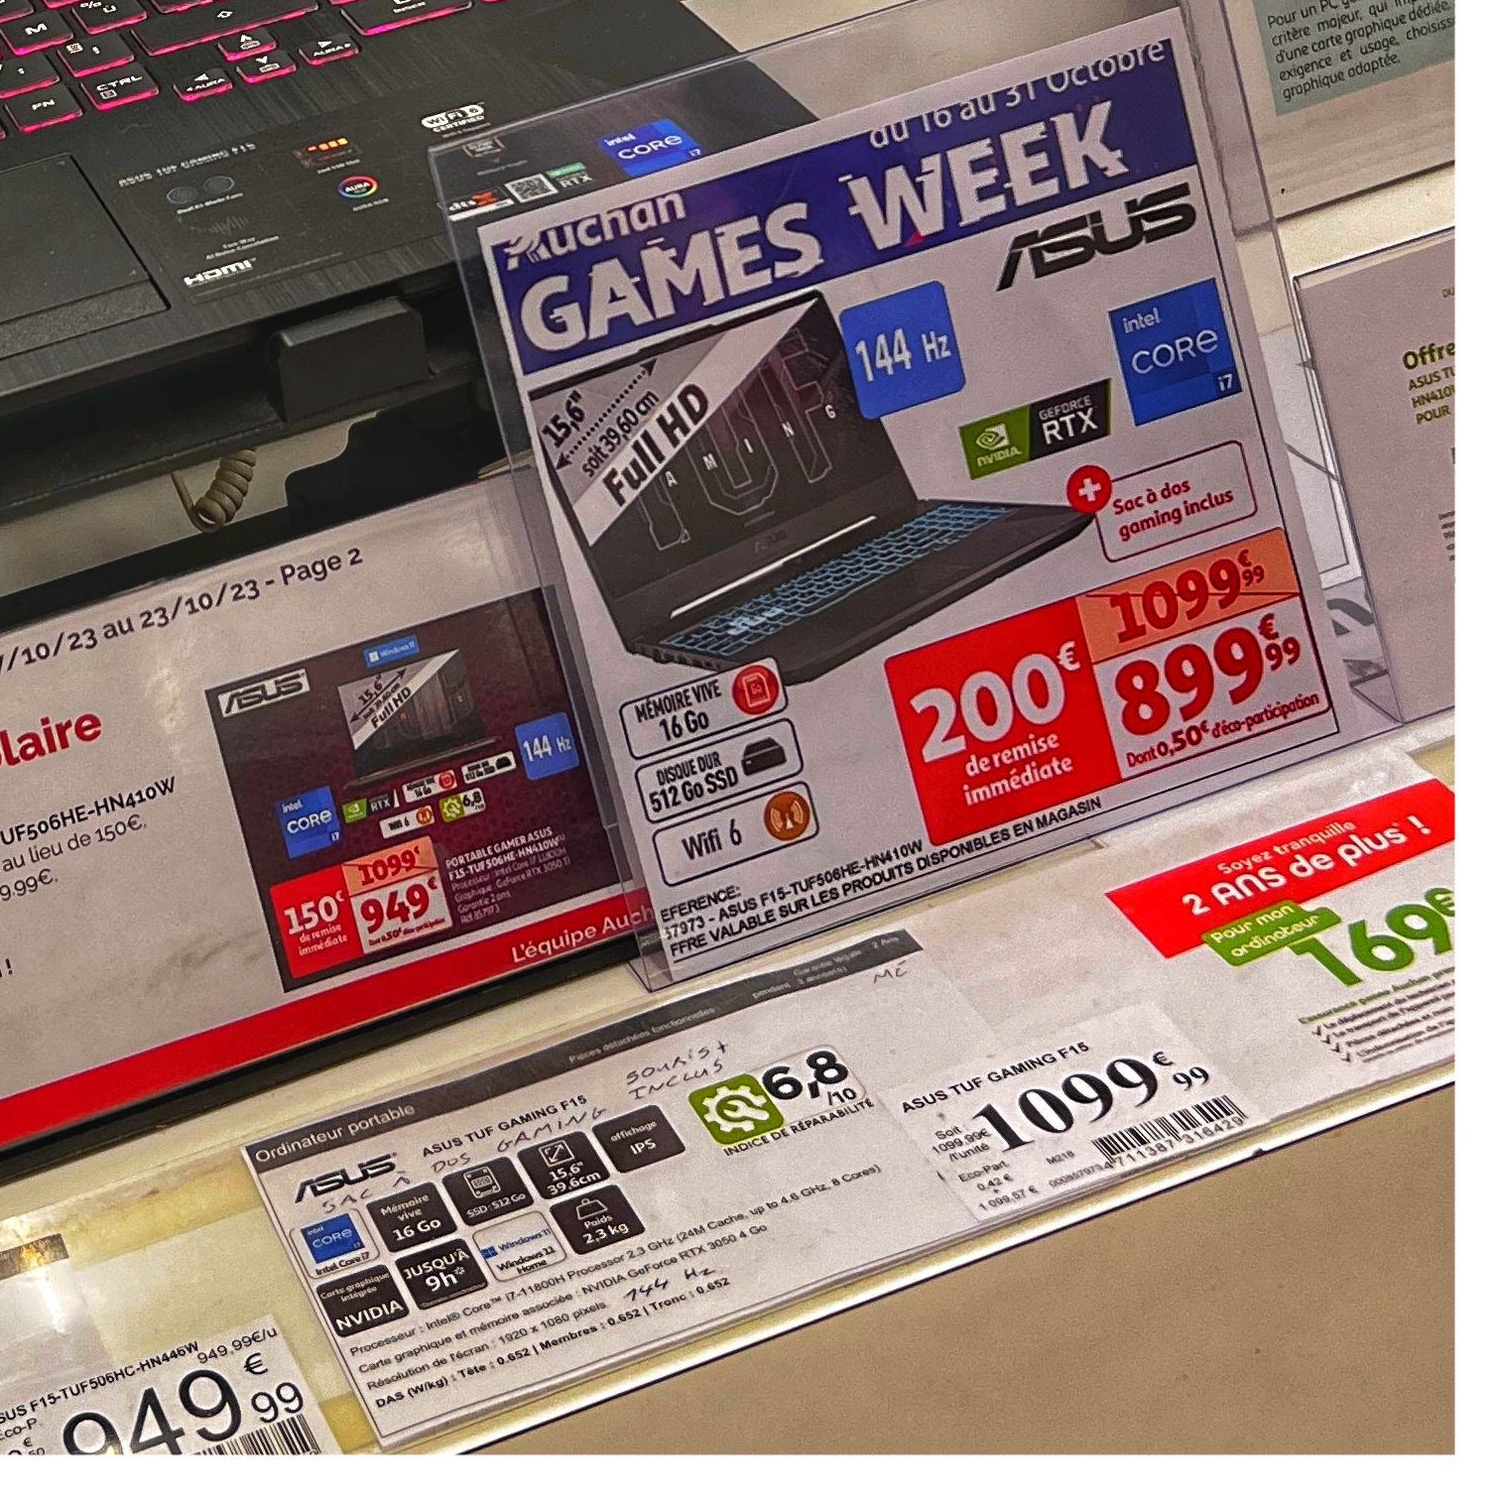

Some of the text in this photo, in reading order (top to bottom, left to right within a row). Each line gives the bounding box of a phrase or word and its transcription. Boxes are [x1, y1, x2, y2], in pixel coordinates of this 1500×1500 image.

[520, 100, 1131, 353] GAMES WEEK
[996, 182, 1197, 292] ASUS
[1118, 487, 1234, 542] gaming inclus
[681, 818, 742, 860] Wifi 6
[1217, 820, 1357, 875] Soyez tranquille
[711, 796, 1102, 942] VALABLE PRODUITS DISPONIBLES MAGASIN
[1230, 914, 1320, 958] ordinateur
[762, 1048, 851, 1104] 6,8
[254, 1102, 415, 1163] Ordinateur portable
[421, 1094, 588, 1159] ASUS TUF GAMING F15
[629, 1137, 658, 1157] IPS
[722, 1097, 875, 1158] INDICE DE RÉPARABILITÉ
[403, 1246, 469, 1280] JUSQU'À
[29, 1339, 199, 1409] F15-TUF506HC-HN446W
